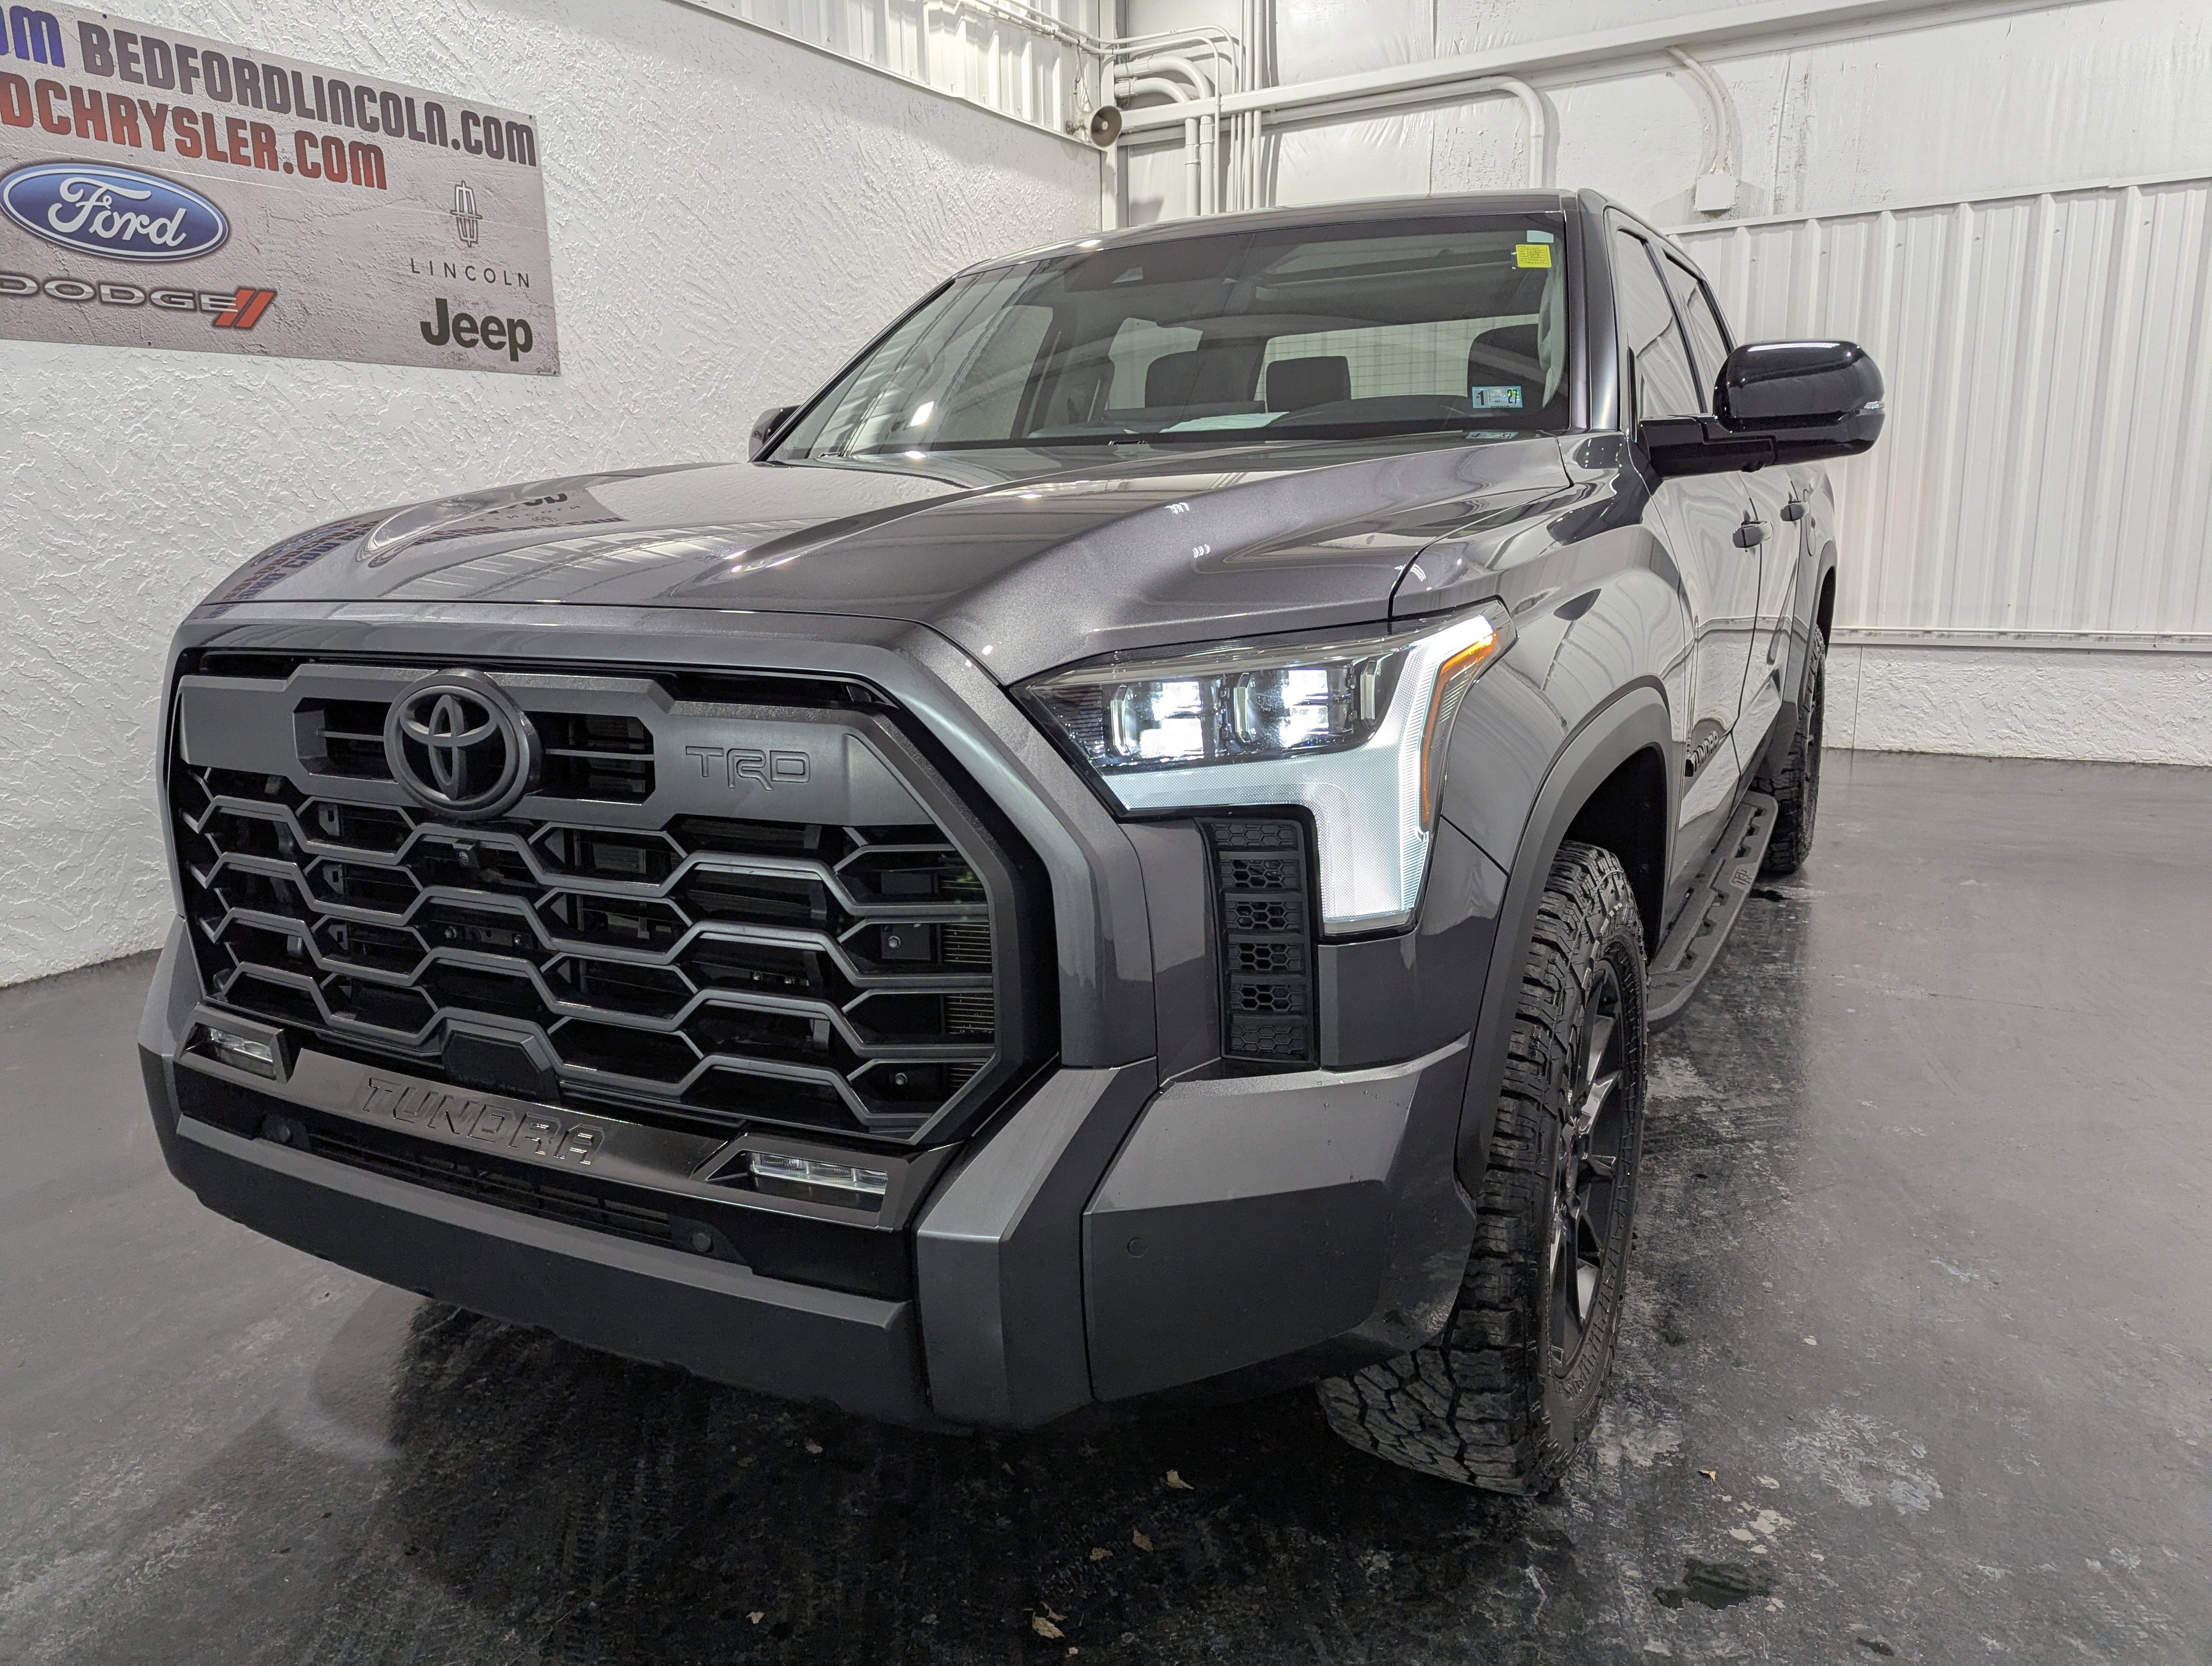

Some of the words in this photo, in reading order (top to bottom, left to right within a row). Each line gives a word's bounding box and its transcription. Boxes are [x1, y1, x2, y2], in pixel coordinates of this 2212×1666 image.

[78, 21, 537, 167] BEDFORDLINCOLN.COM
[48, 176, 187, 248] Ford
[0, 274, 239, 313] DODGE
[410, 257, 530, 288] LINCOLN
[420, 298, 532, 362] Jeep
[1507, 389, 1517, 405] 27
[685, 745, 811, 791] TRD
[1689, 730, 1718, 772] TUNDRA
[362, 1076, 606, 1165] TUNDRA
